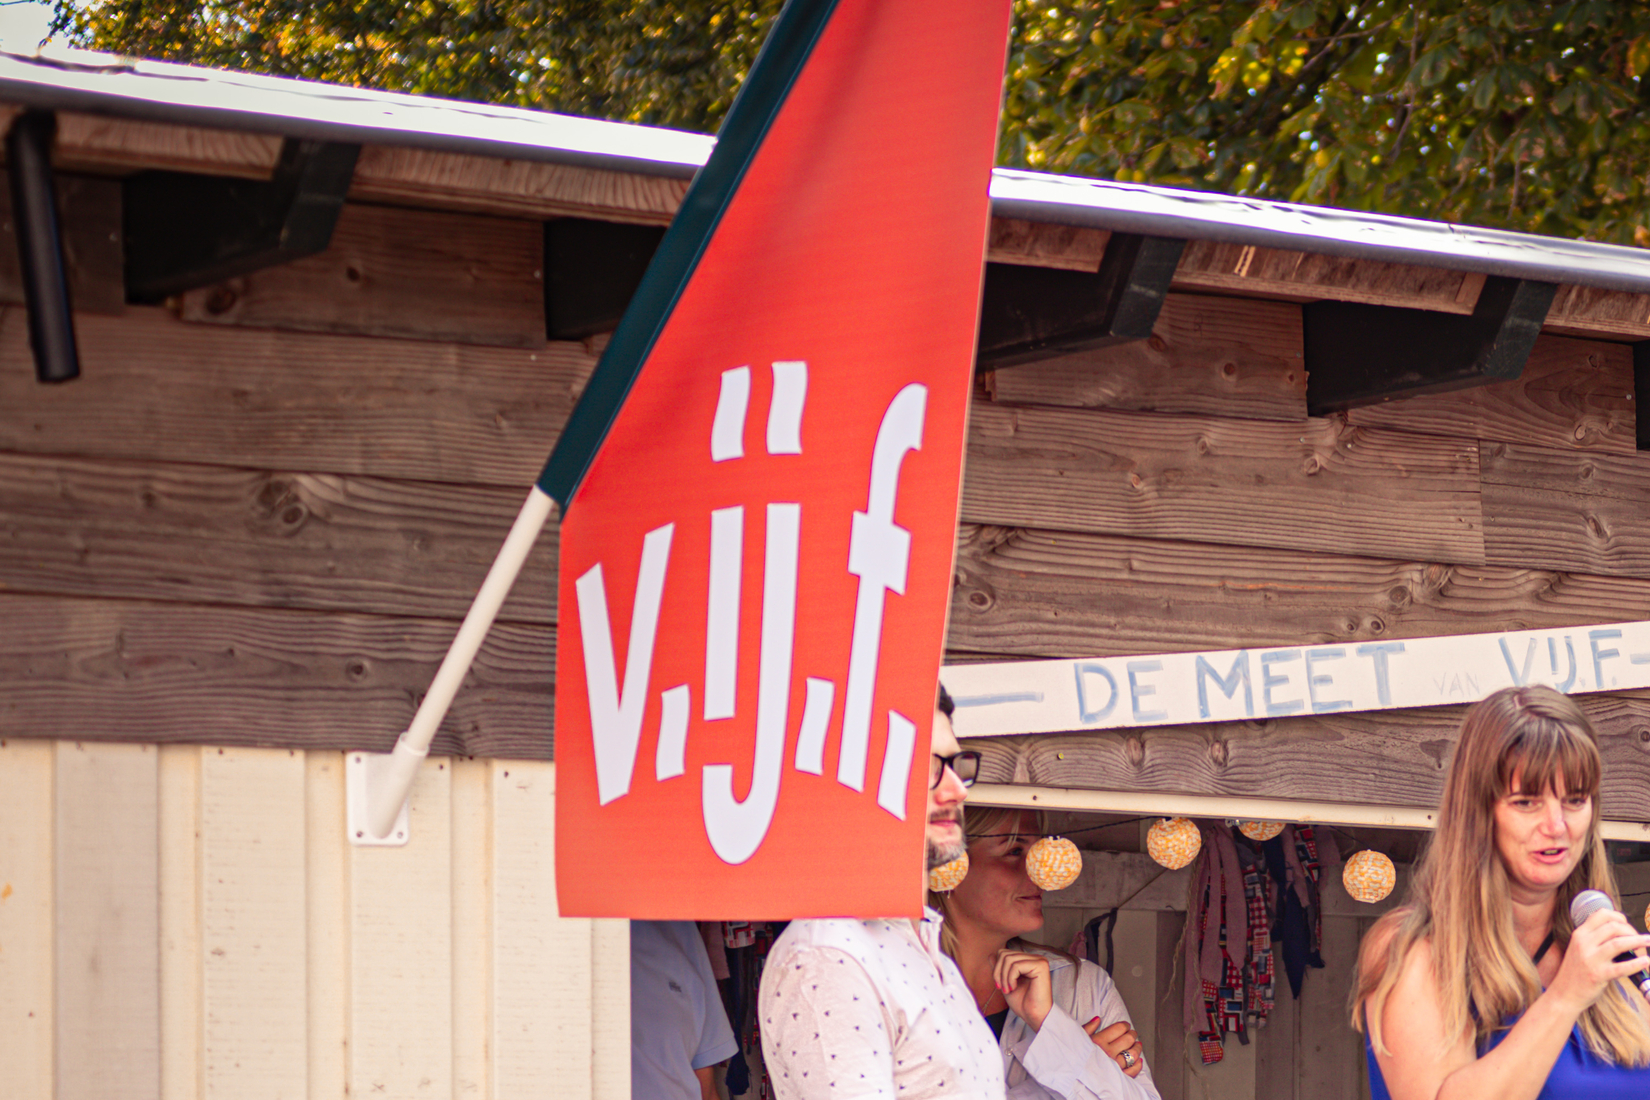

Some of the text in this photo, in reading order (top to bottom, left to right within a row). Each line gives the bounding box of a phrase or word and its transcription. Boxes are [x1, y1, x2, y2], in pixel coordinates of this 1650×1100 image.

[1073, 659, 1169, 725] DE
[1195, 642, 1406, 719] MEET
[1432, 671, 1481, 697] VAN
